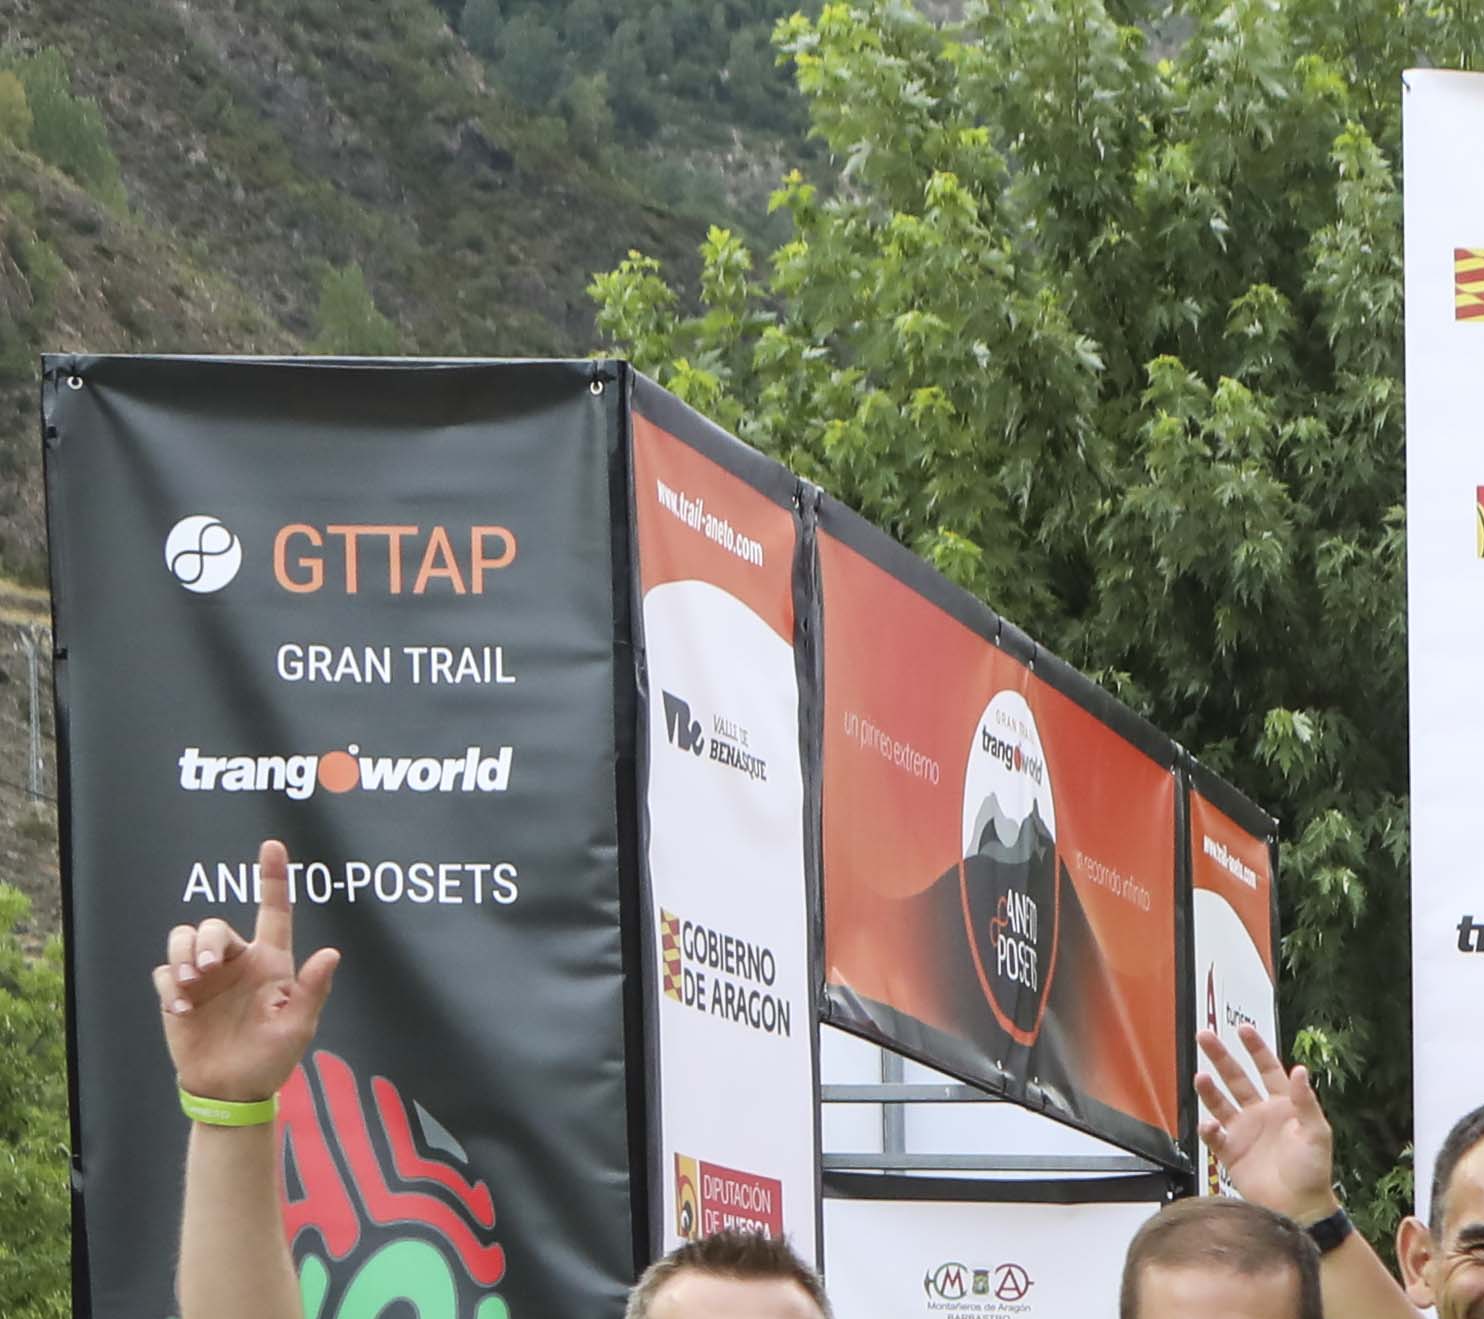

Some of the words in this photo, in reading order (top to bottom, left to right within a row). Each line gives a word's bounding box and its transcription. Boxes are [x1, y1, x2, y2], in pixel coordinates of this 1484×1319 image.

[656, 480, 764, 568] www.trail-aneto.com
[274, 524, 516, 594] GTTAP
[278, 644, 390, 683] GRAN
[404, 647, 515, 683] TRAIL
[179, 744, 513, 800] trangoworld
[709, 738, 767, 783] BENASQUE
[893, 740, 940, 786] extremo
[682, 919, 776, 988] GOBIERNO
[682, 967, 706, 1011] DE
[710, 979, 791, 1038] ARAGON
[703, 1174, 773, 1215] DIPUTACIÓN
[705, 1208, 721, 1235] DE
[928, 1301, 984, 1313] Montañeros
[986, 1302, 996, 1312] de
[999, 1302, 1031, 1315] Aragón
